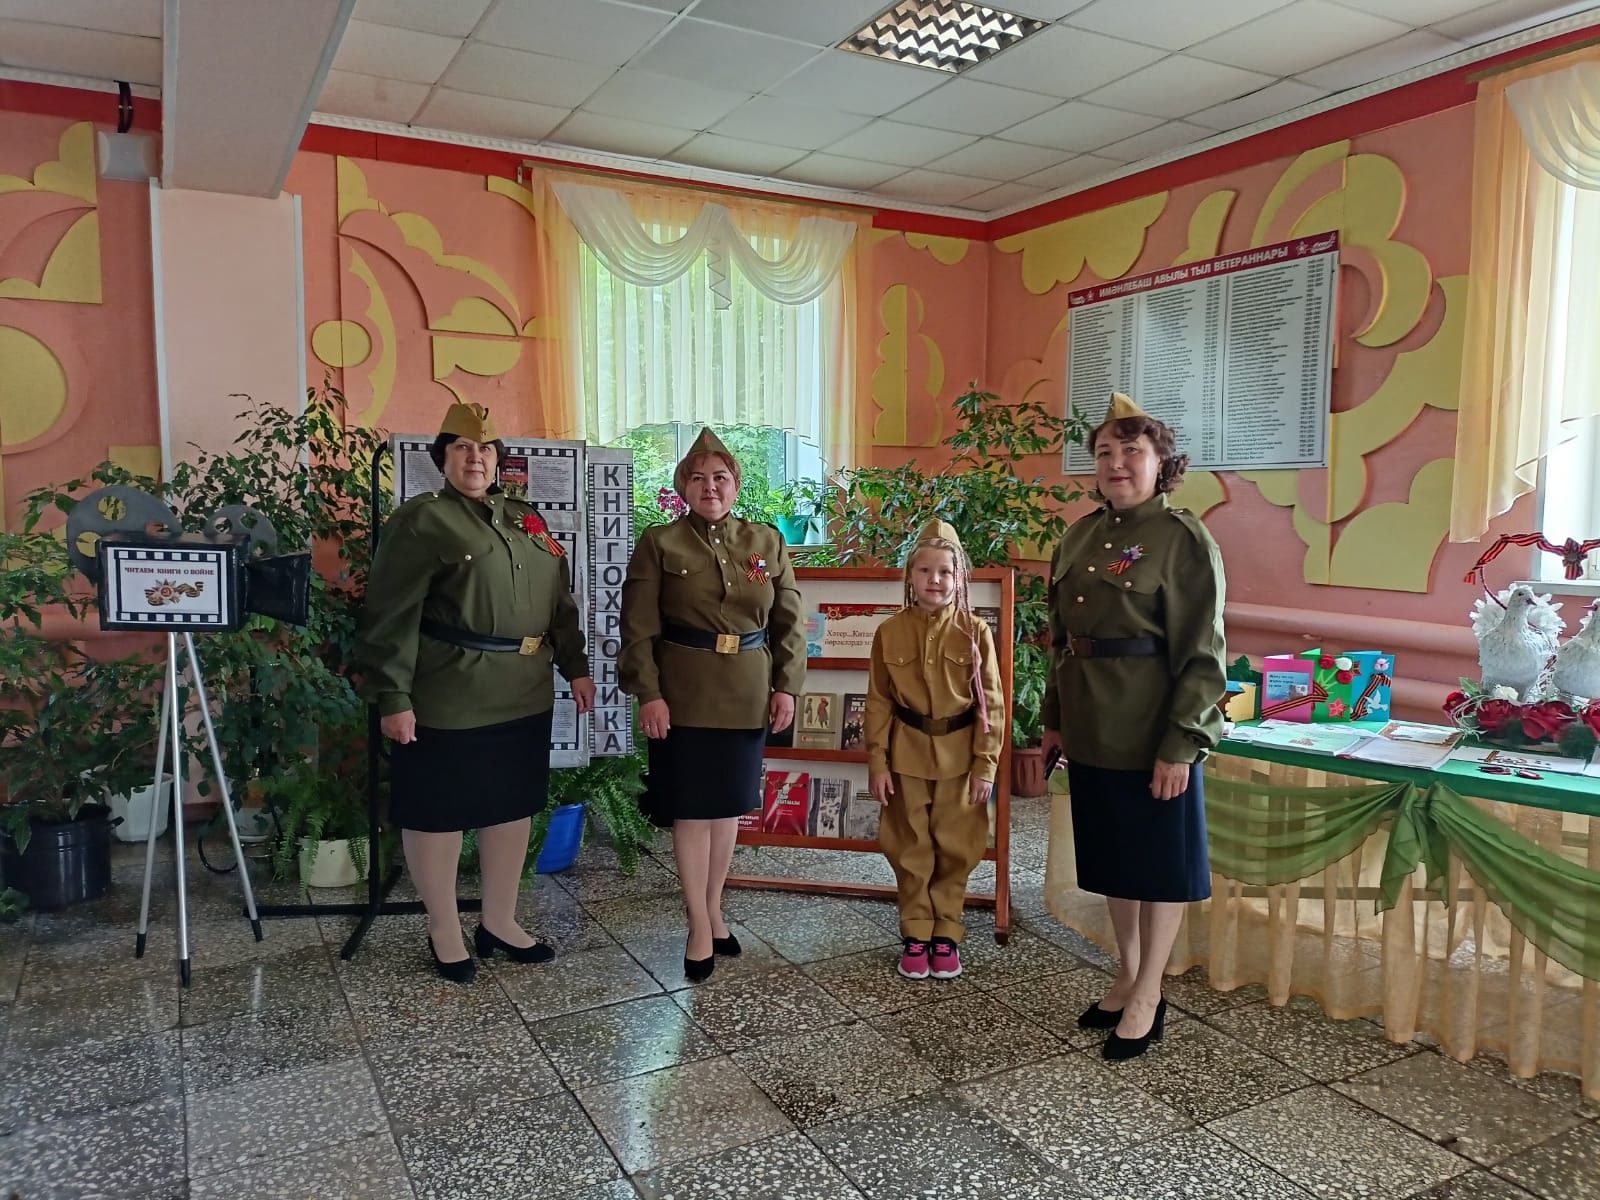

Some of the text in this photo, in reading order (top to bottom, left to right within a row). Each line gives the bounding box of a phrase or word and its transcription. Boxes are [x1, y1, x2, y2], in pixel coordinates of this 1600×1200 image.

[1099, 276, 1153, 299] ИМӘНЛЕБАШ
[1154, 269, 1189, 287] АВЫЛЫ
[1191, 264, 1212, 277] ТЫЛ
[1214, 246, 1289, 273] ВЕТЕРАННАРЫ
[190, 568, 214, 576] ВОЙНЕ
[602, 465, 622, 752] КНИГОХРОНИКА
